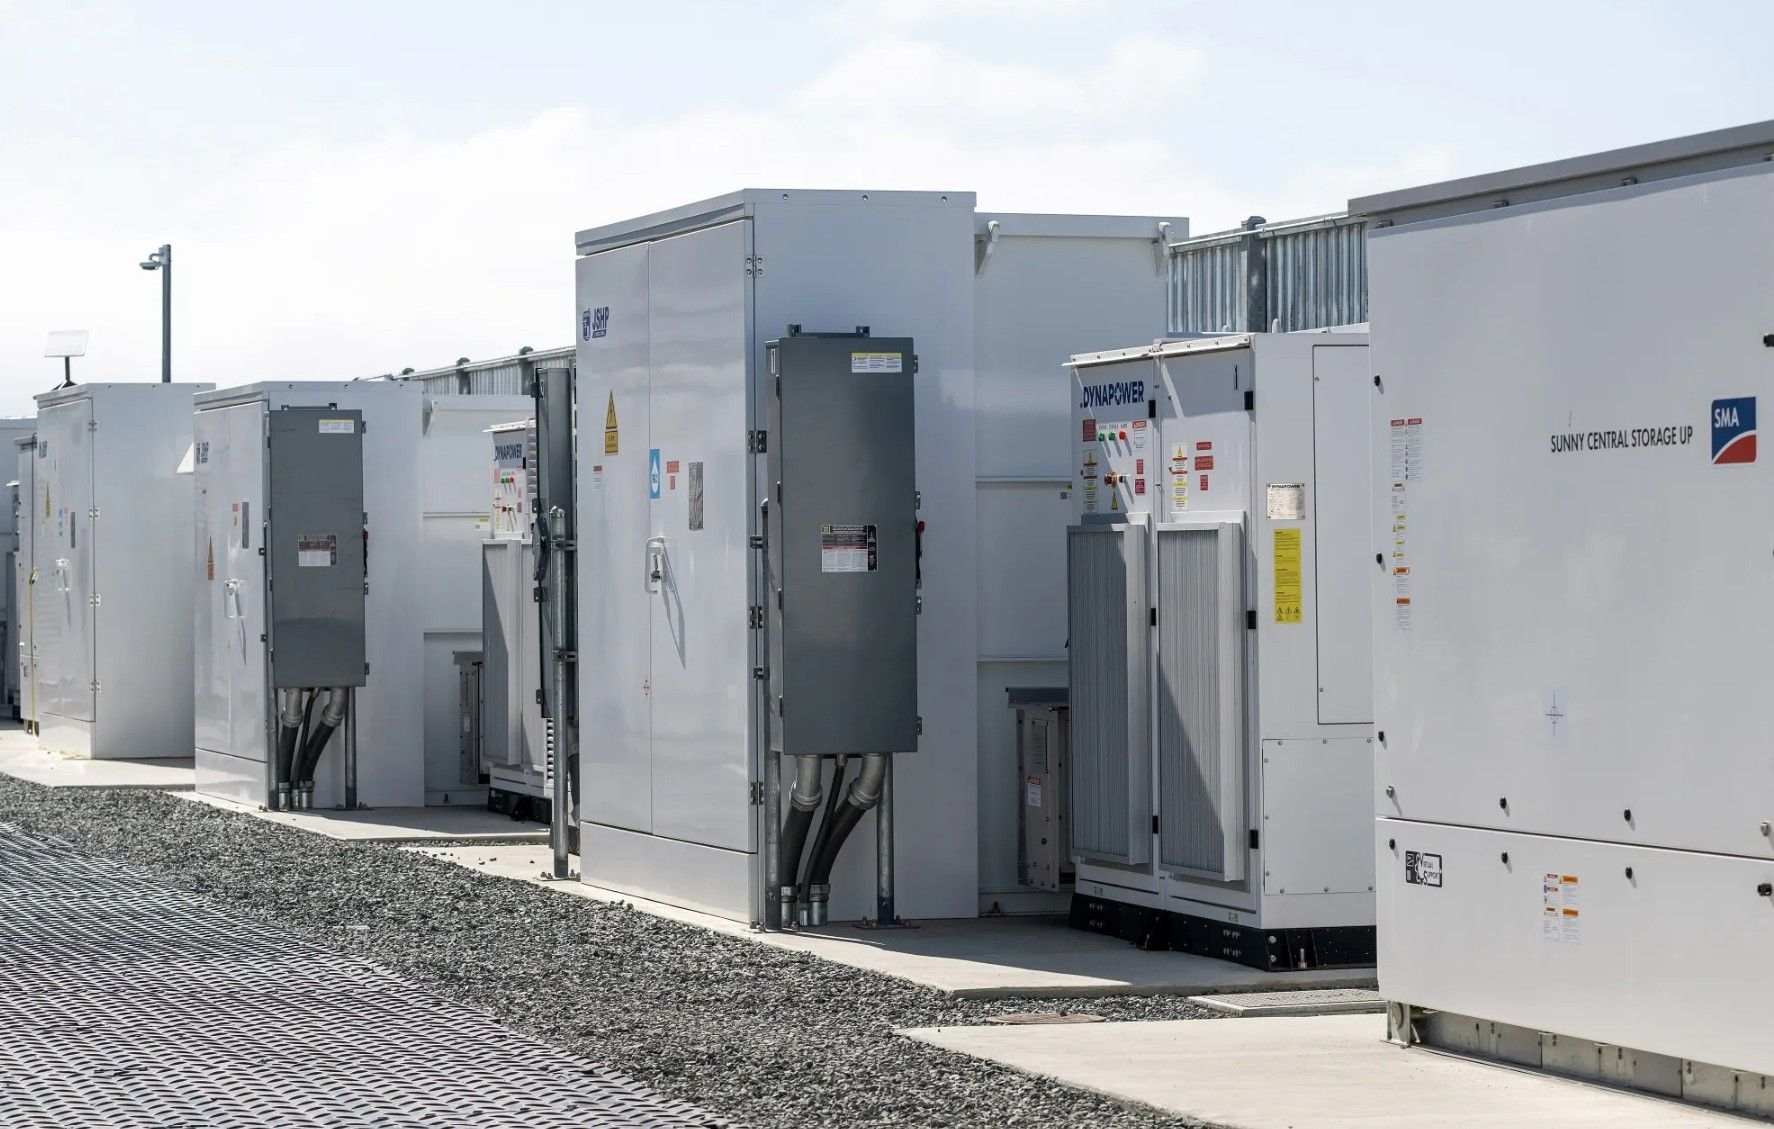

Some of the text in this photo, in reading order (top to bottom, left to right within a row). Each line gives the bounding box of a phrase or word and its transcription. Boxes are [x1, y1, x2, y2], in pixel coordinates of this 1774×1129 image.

[592, 306, 609, 330] JSHP
[1714, 407, 1739, 428] SMA
[1551, 425, 1693, 453] SUNNY CENTRAL STORAGE UP
